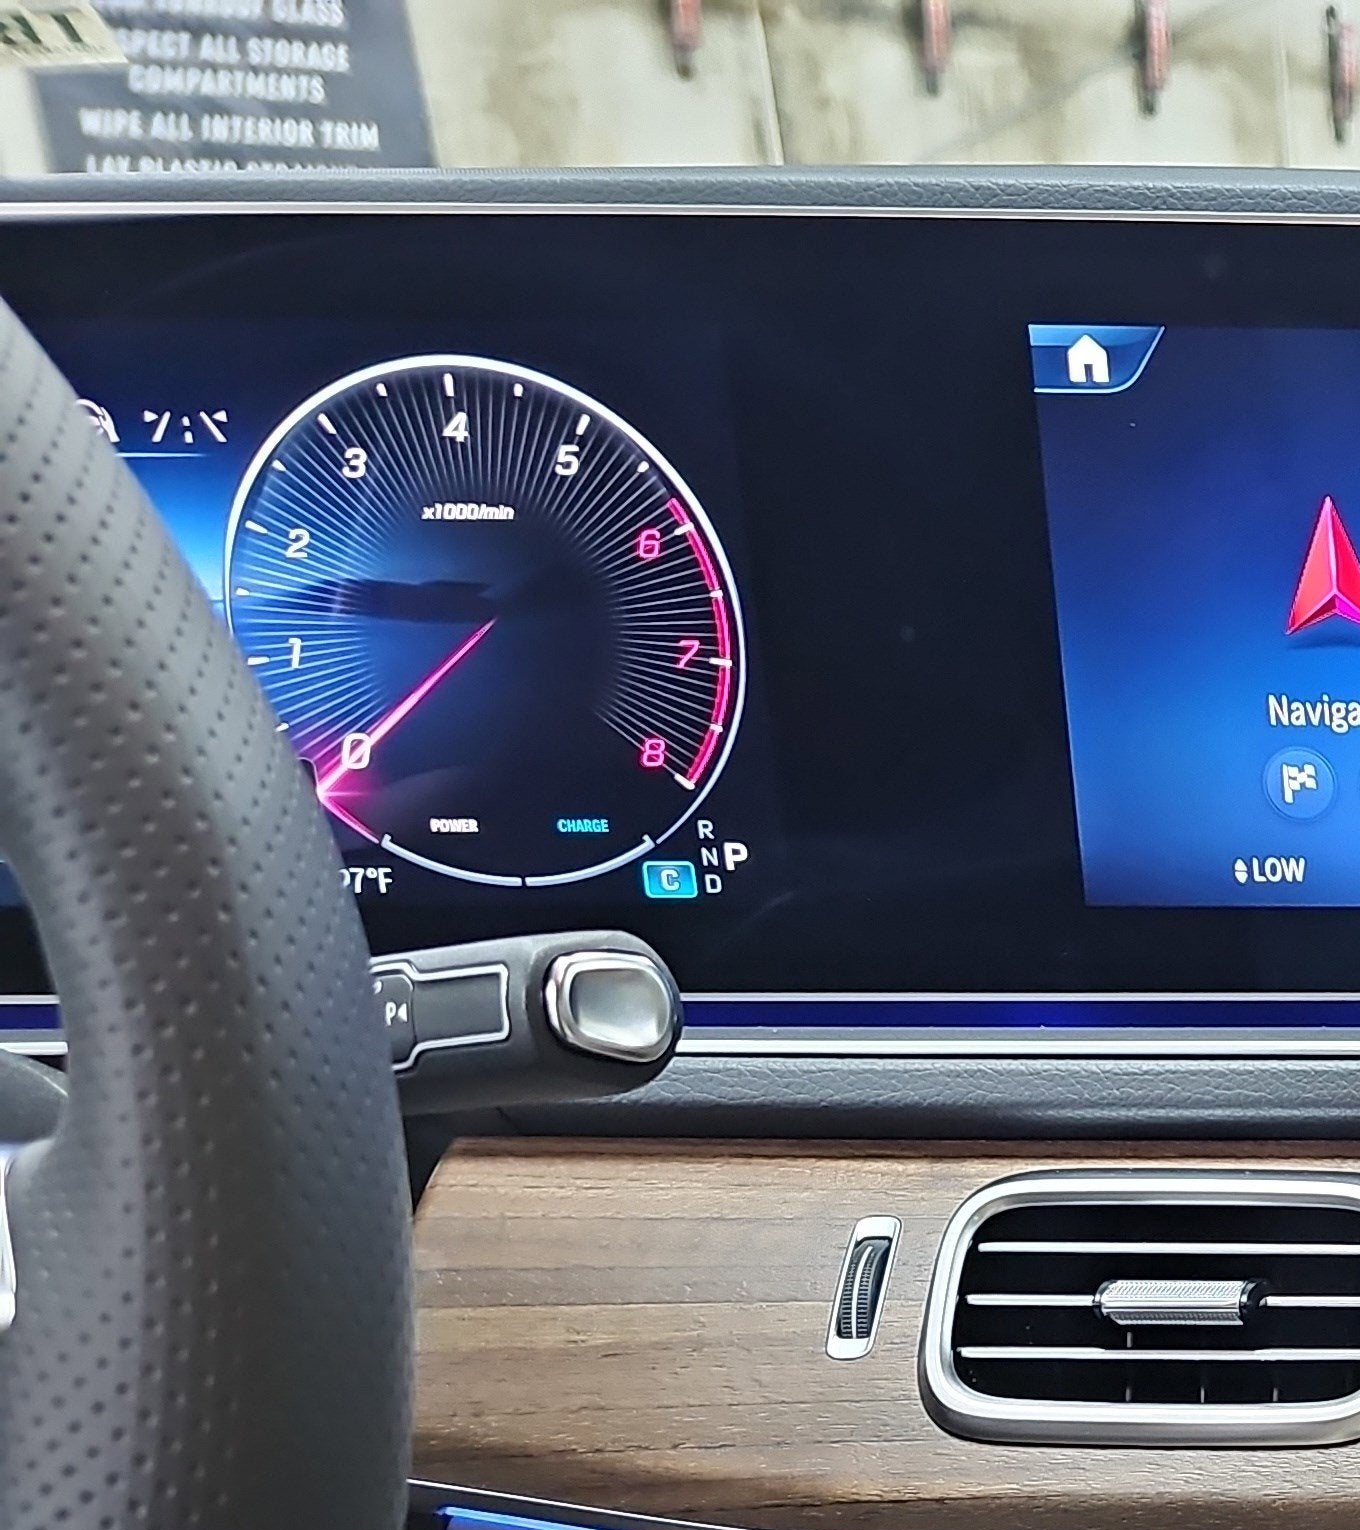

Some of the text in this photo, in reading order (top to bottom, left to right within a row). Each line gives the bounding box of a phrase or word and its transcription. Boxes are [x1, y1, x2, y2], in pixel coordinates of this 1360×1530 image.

[200, 33, 241, 64] ALL
[247, 36, 350, 72] STORAGE
[128, 65, 326, 103] COMPARTMENTS
[79, 107, 380, 150] WIPE ALL INTERIOR TRIM
[443, 413, 468, 441] 4
[343, 449, 366, 478] 3
[556, 446, 579, 475] 5
[421, 503, 515, 520] x1000/min
[285, 529, 310, 558] 2
[637, 530, 660, 558] 6
[287, 637, 302, 667] 1
[677, 639, 699, 668] 7
[342, 734, 372, 769] 0
[642, 738, 665, 767] 8
[430, 818, 479, 833] POWER
[557, 818, 609, 834] CHARGE
[698, 820, 714, 839] R
[701, 848, 718, 867] N
[723, 842, 748, 871] P
[1252, 858, 1305, 883] LOW
[660, 869, 680, 891] C
[705, 874, 722, 894] D
